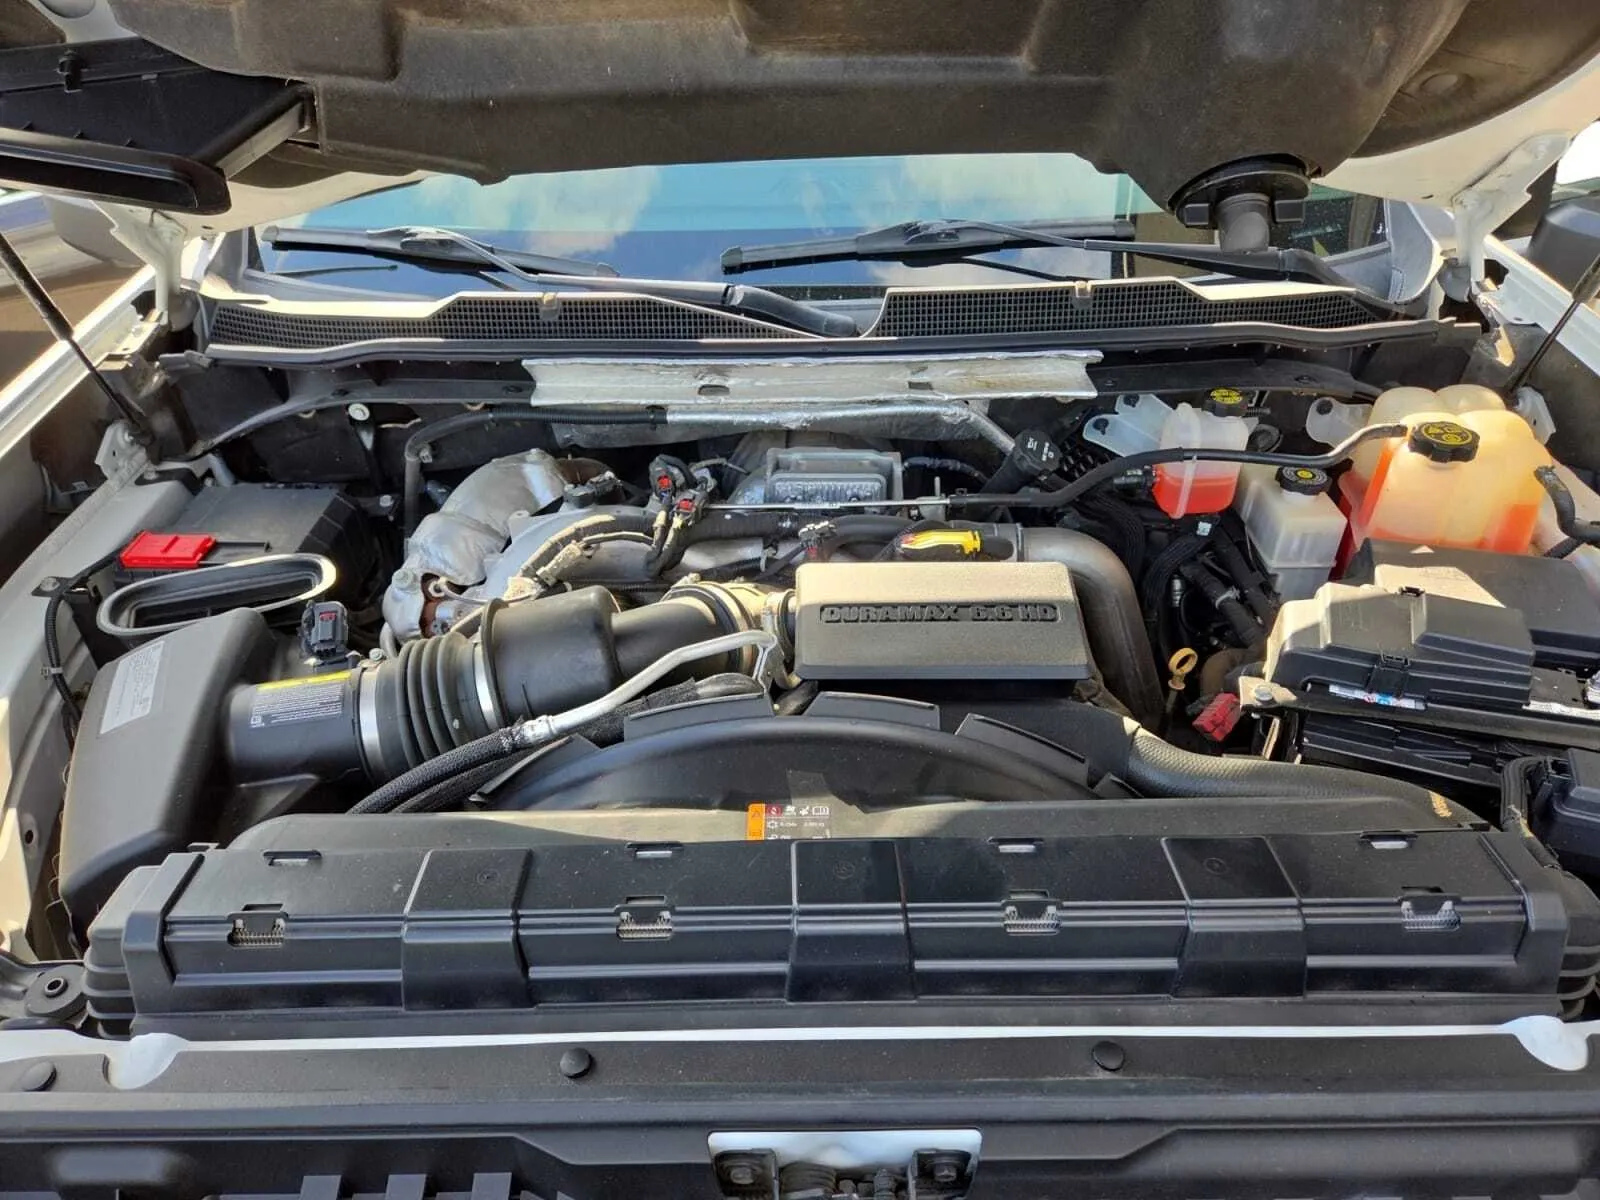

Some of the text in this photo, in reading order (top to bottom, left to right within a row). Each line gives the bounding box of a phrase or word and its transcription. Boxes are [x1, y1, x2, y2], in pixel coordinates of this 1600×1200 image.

[823, 605, 1057, 623] DURAMAX 6.6 HD
